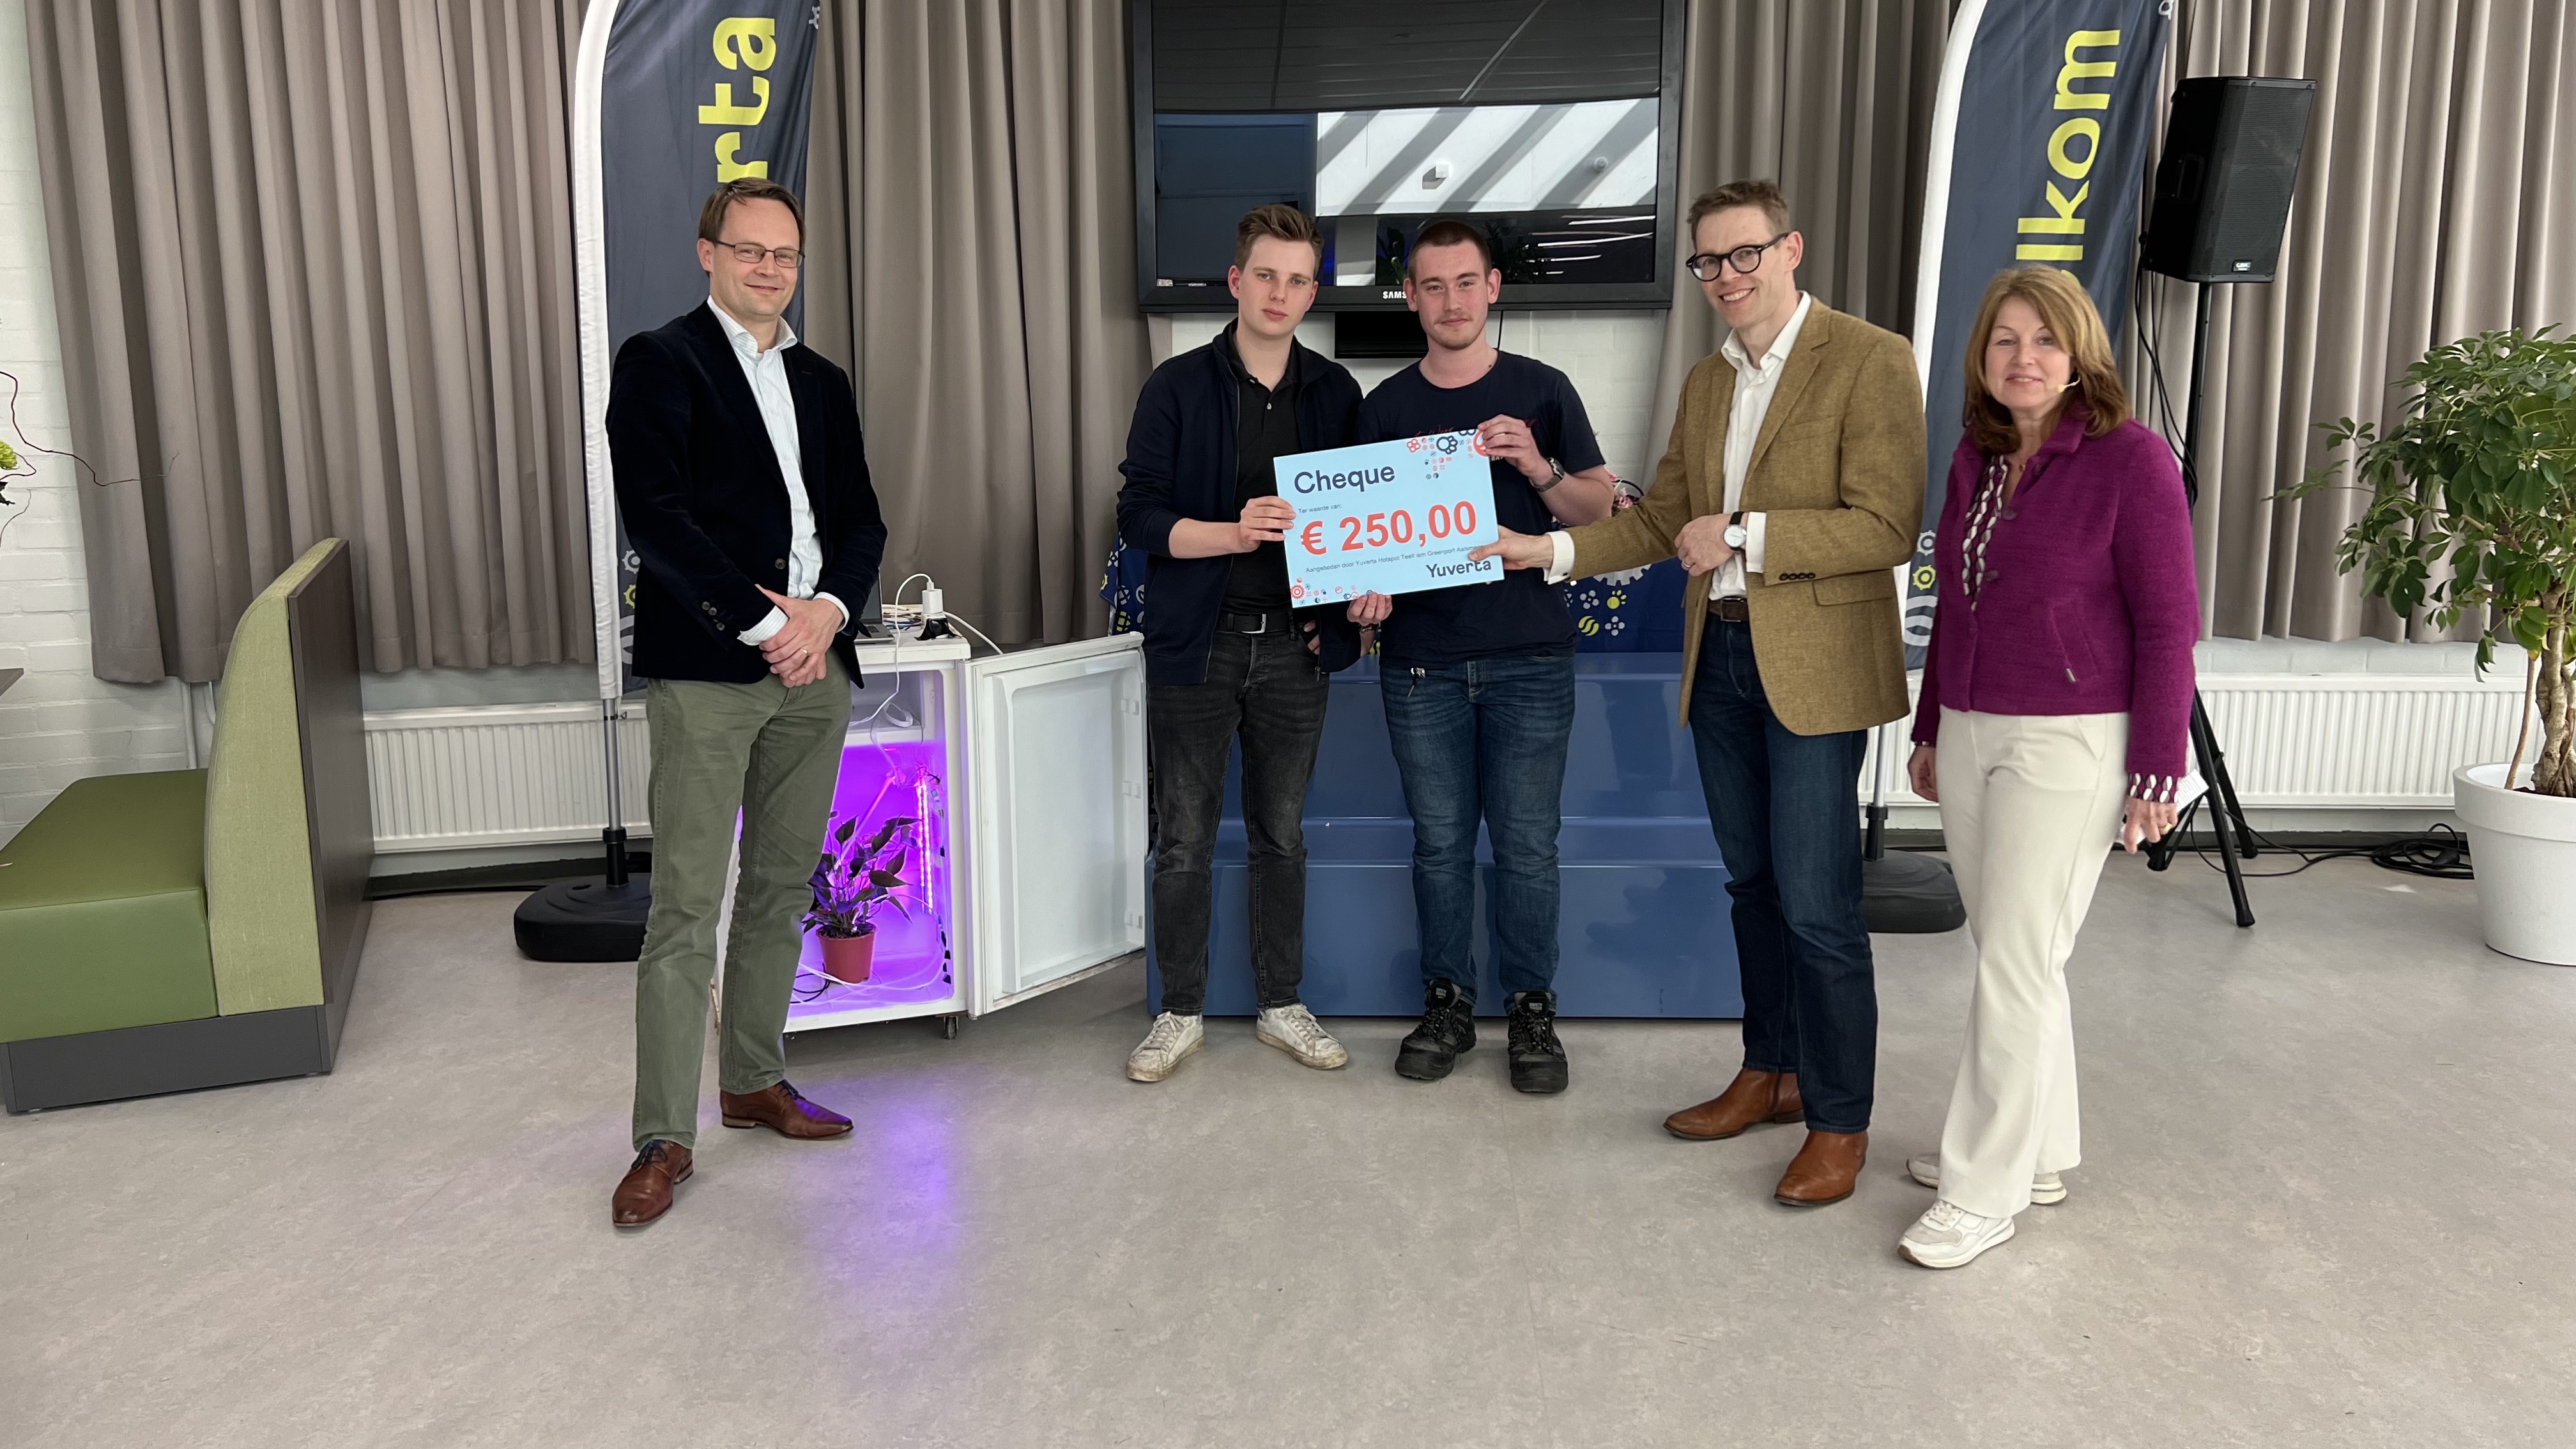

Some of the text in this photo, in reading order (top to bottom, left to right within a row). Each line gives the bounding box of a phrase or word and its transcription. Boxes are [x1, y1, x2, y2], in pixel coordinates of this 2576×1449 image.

[699, 17, 776, 182] rta
[2016, 29, 2120, 261] lkom
[1383, 291, 1407, 299] SAMS
[1294, 466, 1395, 493] Cheque
[1300, 501, 1476, 555] € 250,00
[1306, 564, 1340, 572] Aangeboden
[1427, 548, 1455, 556] Greenport
[1425, 560, 1491, 578] Yuverta
